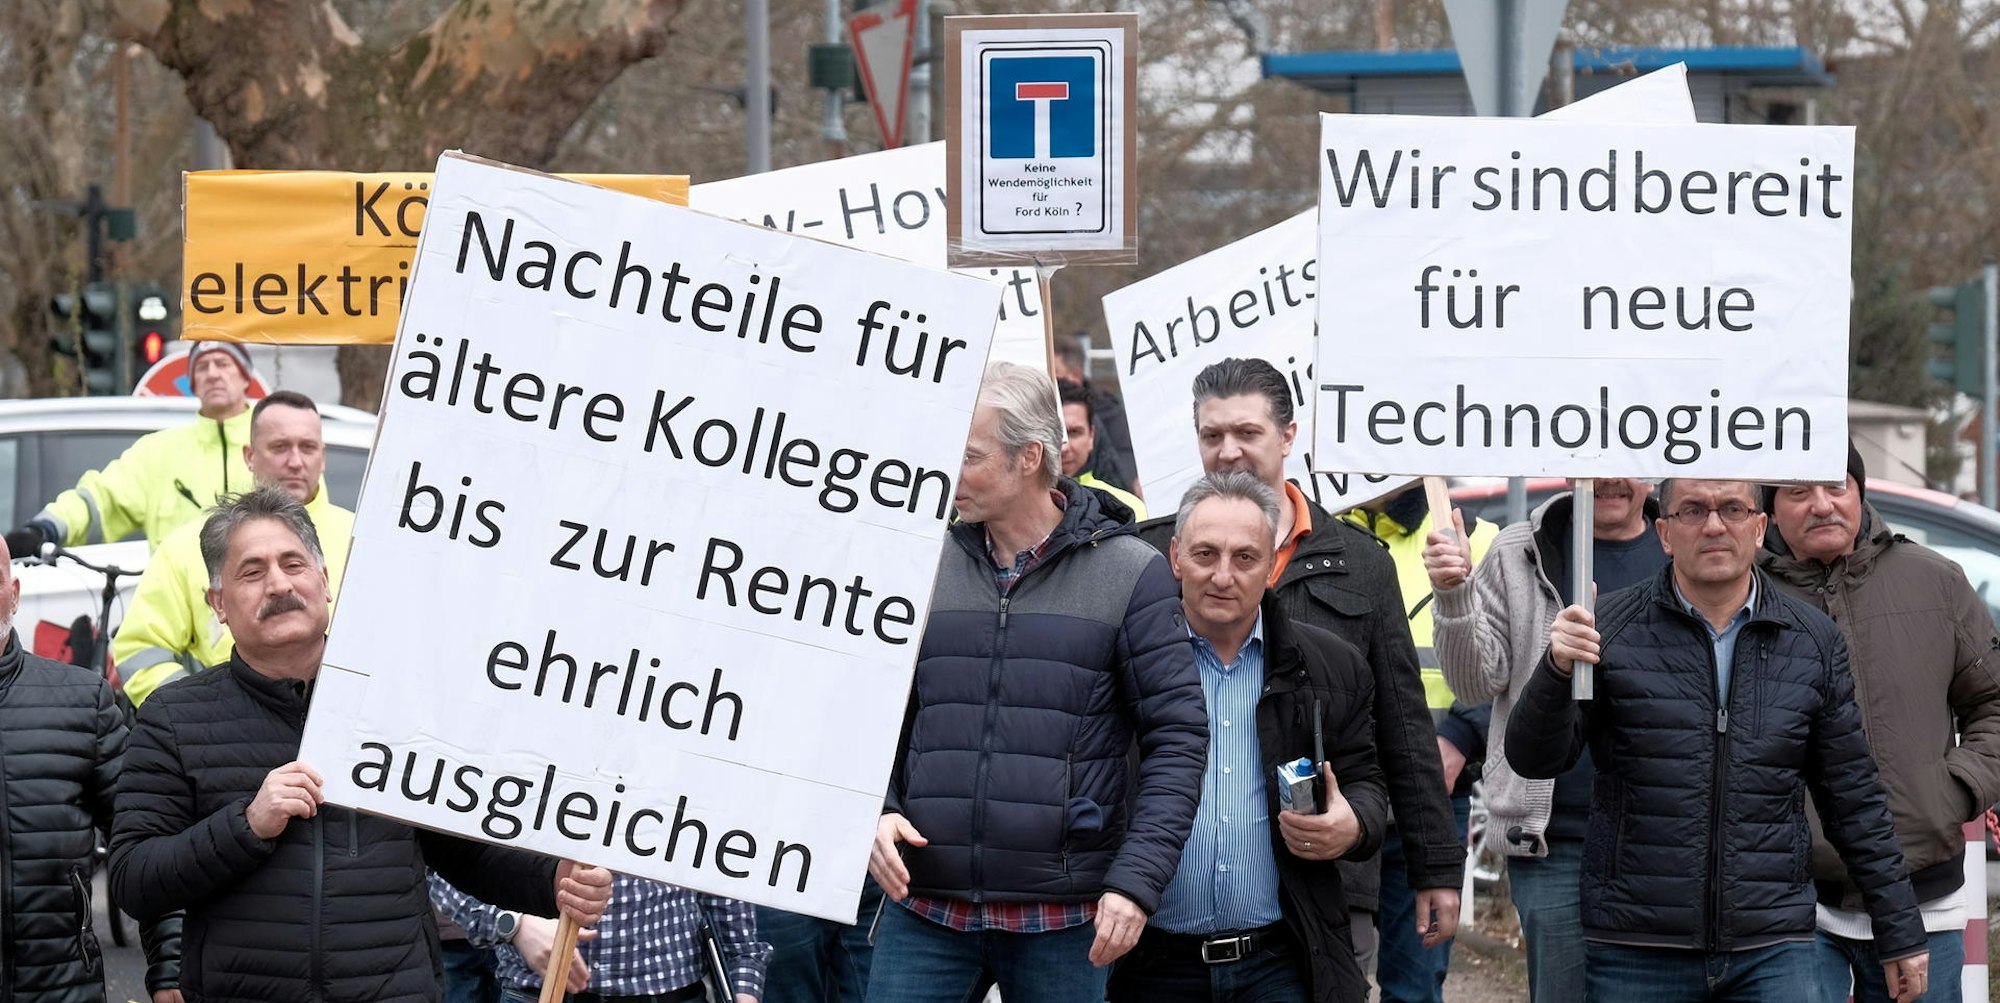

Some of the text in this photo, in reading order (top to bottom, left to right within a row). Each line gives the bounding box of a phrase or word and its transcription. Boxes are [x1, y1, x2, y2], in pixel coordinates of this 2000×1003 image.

[988, 177, 1093, 189] Wendemöglichkeit
[1024, 163, 1057, 173] Keine
[1032, 192, 1048, 202] für
[1326, 148, 1843, 219] Wir sind bereit
[1015, 202, 1083, 217] Ford Köln ?
[455, 211, 967, 385] Nachteile für
[1414, 265, 1755, 332] für neue
[400, 333, 951, 520] ältere Kollegen
[1320, 384, 1811, 465] Technologien
[398, 461, 915, 645] bis zur Rente
[486, 629, 743, 741] ehrlich
[351, 741, 812, 893] ausgleichen
